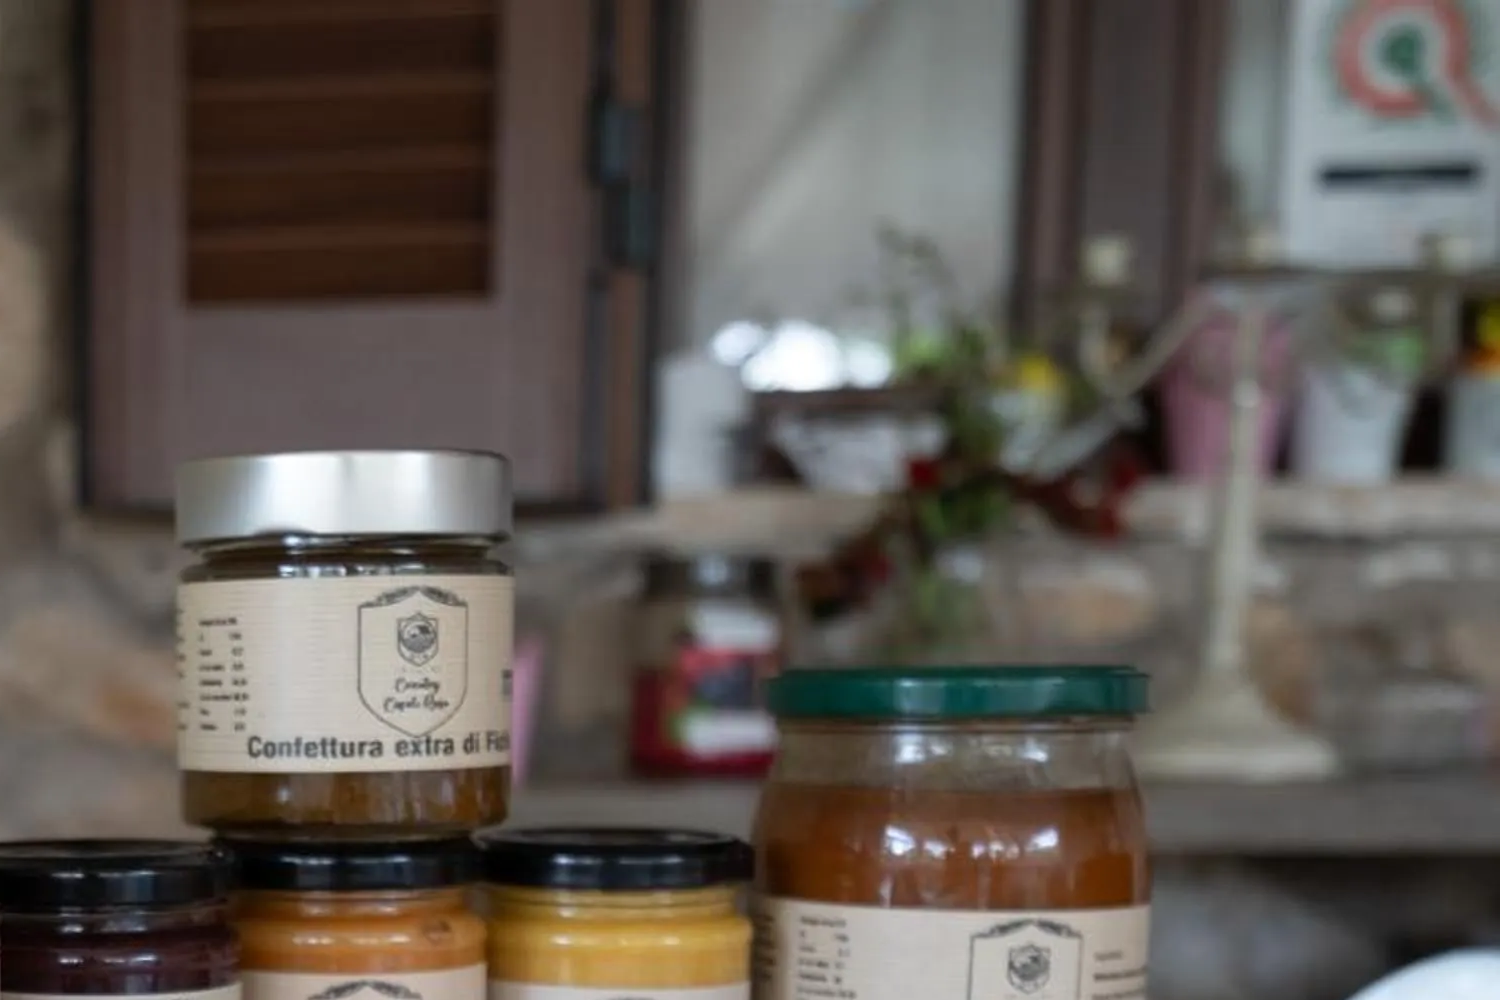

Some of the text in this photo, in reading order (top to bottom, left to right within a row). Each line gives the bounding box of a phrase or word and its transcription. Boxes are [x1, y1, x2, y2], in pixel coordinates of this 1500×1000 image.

[247, 735, 384, 759] Confettura
[395, 735, 455, 758] extra
[463, 731, 480, 755] di
